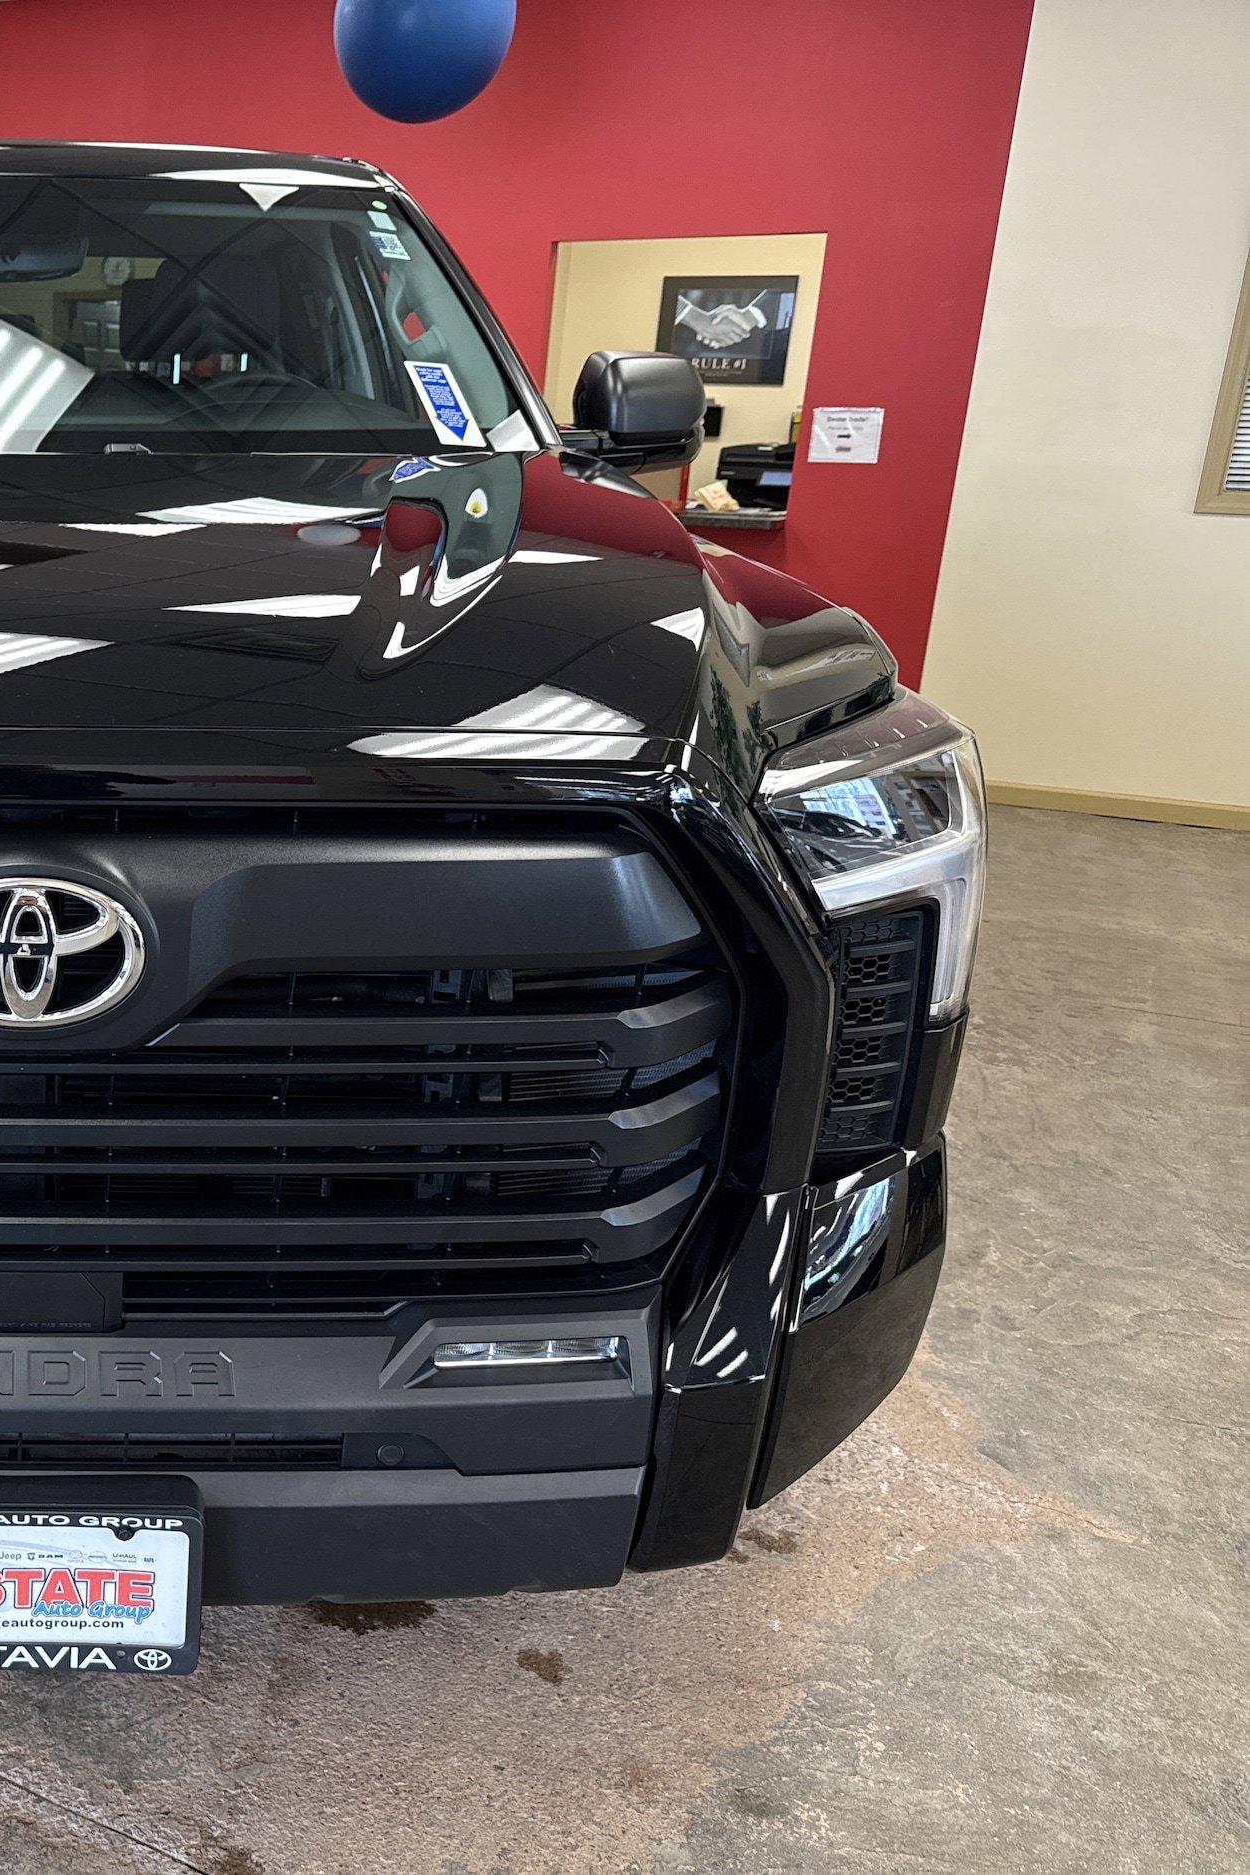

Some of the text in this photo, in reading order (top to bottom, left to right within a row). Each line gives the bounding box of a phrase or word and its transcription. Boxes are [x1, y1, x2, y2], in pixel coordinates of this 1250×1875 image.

[691, 357, 731, 370] RULE
[78, 1515, 183, 1530] GROUP
[33, 1600, 152, 1625] Auto Group
